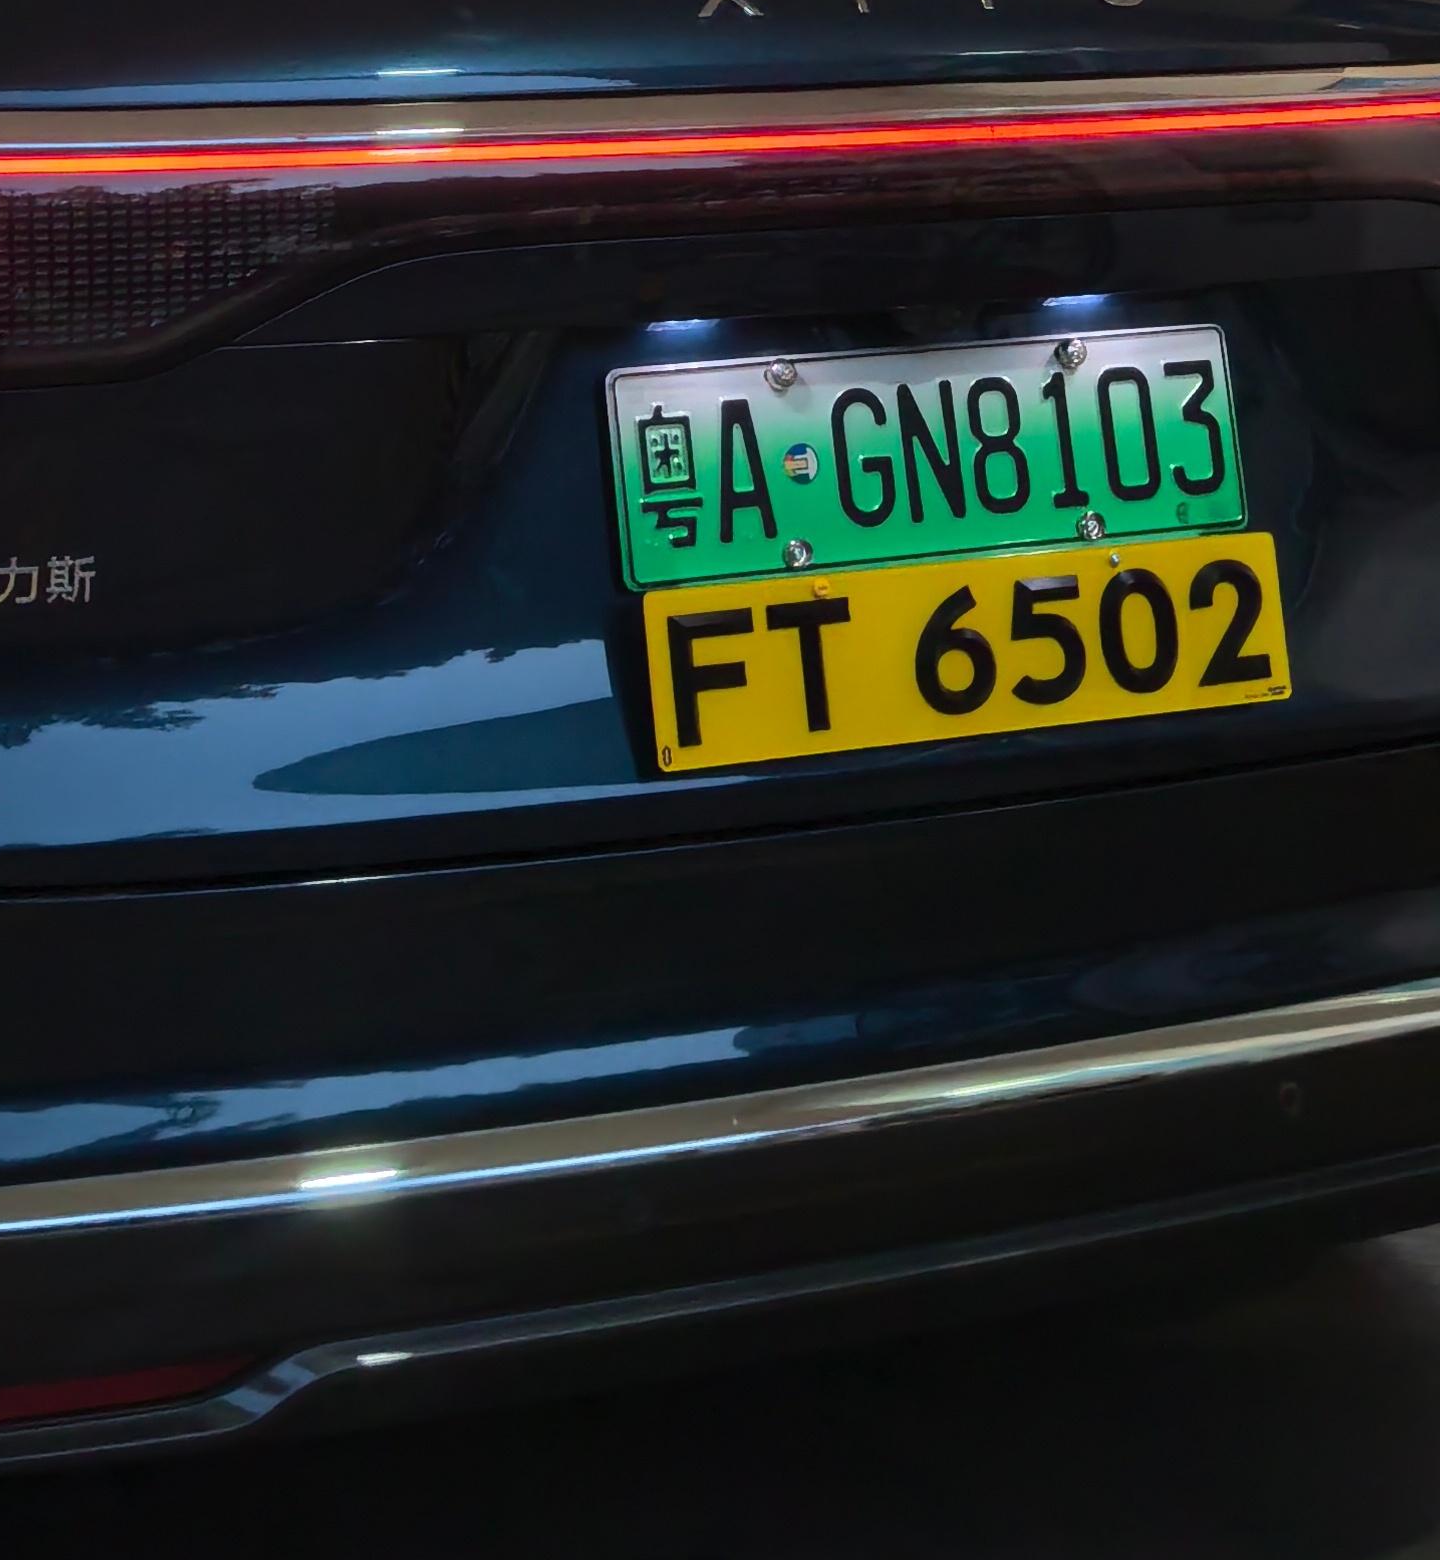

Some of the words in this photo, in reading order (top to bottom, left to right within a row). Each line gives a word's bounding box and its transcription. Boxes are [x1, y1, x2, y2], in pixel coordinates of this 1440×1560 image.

[640, 397, 778, 550] 粤A
[830, 358, 1227, 528] GN8103
[667, 596, 850, 748] FT
[914, 557, 1274, 720] 6502
